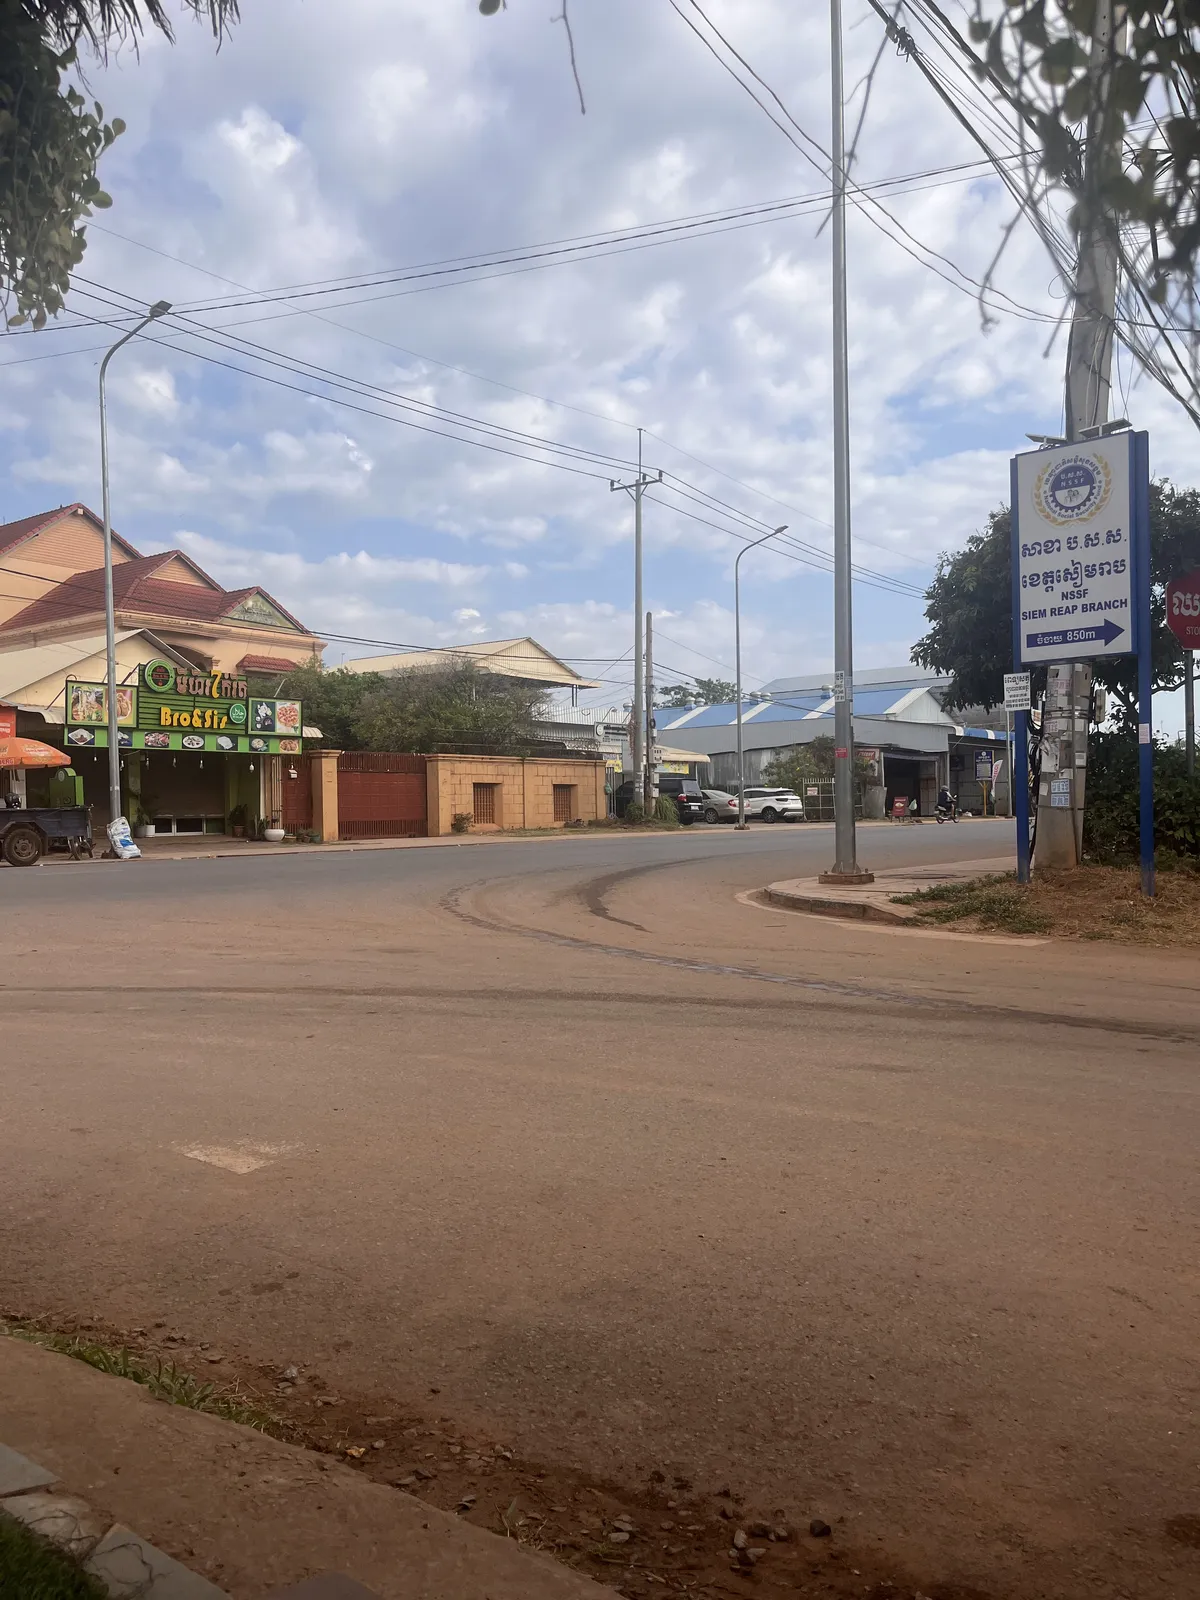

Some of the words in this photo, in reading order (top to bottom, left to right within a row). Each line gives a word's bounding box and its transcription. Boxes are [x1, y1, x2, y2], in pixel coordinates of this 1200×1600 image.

[1021, 538, 1061, 557] សាខា
[1021, 559, 1127, 593] ខេត្តសៀមរាប
[1061, 588, 1089, 601] NSSF
[1021, 608, 1047, 620] SIEM
[1050, 604, 1078, 617] REAP
[1081, 598, 1128, 613] BRANCH
[1066, 630, 1096, 641] 850m
[1185, 626, 1200, 636] STO
[160, 707, 228, 729] Bro&Sis
